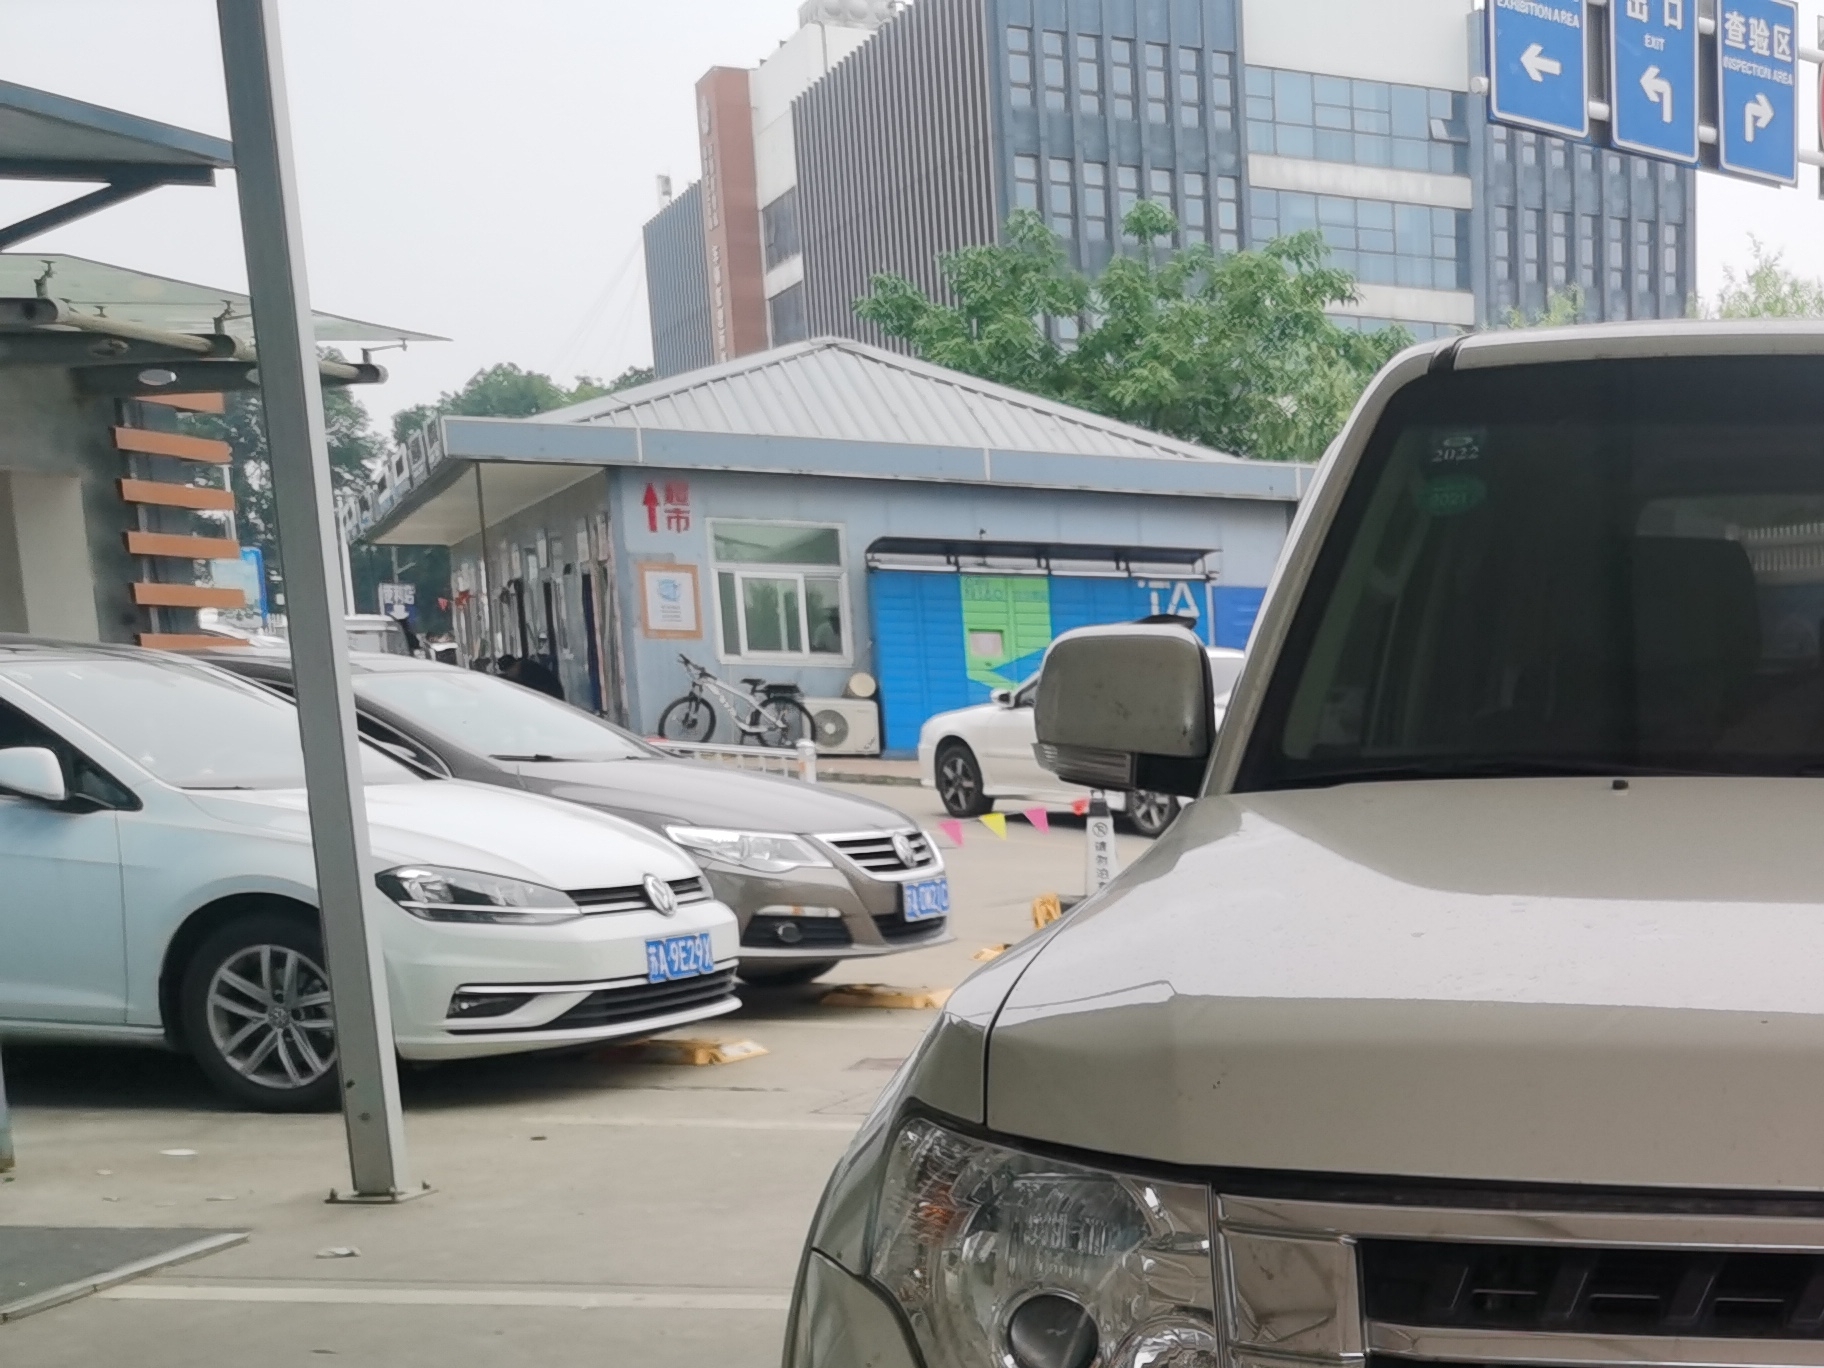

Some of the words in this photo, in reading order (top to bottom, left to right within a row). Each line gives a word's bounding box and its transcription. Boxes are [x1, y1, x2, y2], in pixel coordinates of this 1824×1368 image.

[1643, 33, 1665, 51] EXIT
[1724, 10, 1793, 63] 查验区
[1722, 55, 1771, 80] INSPECTION
